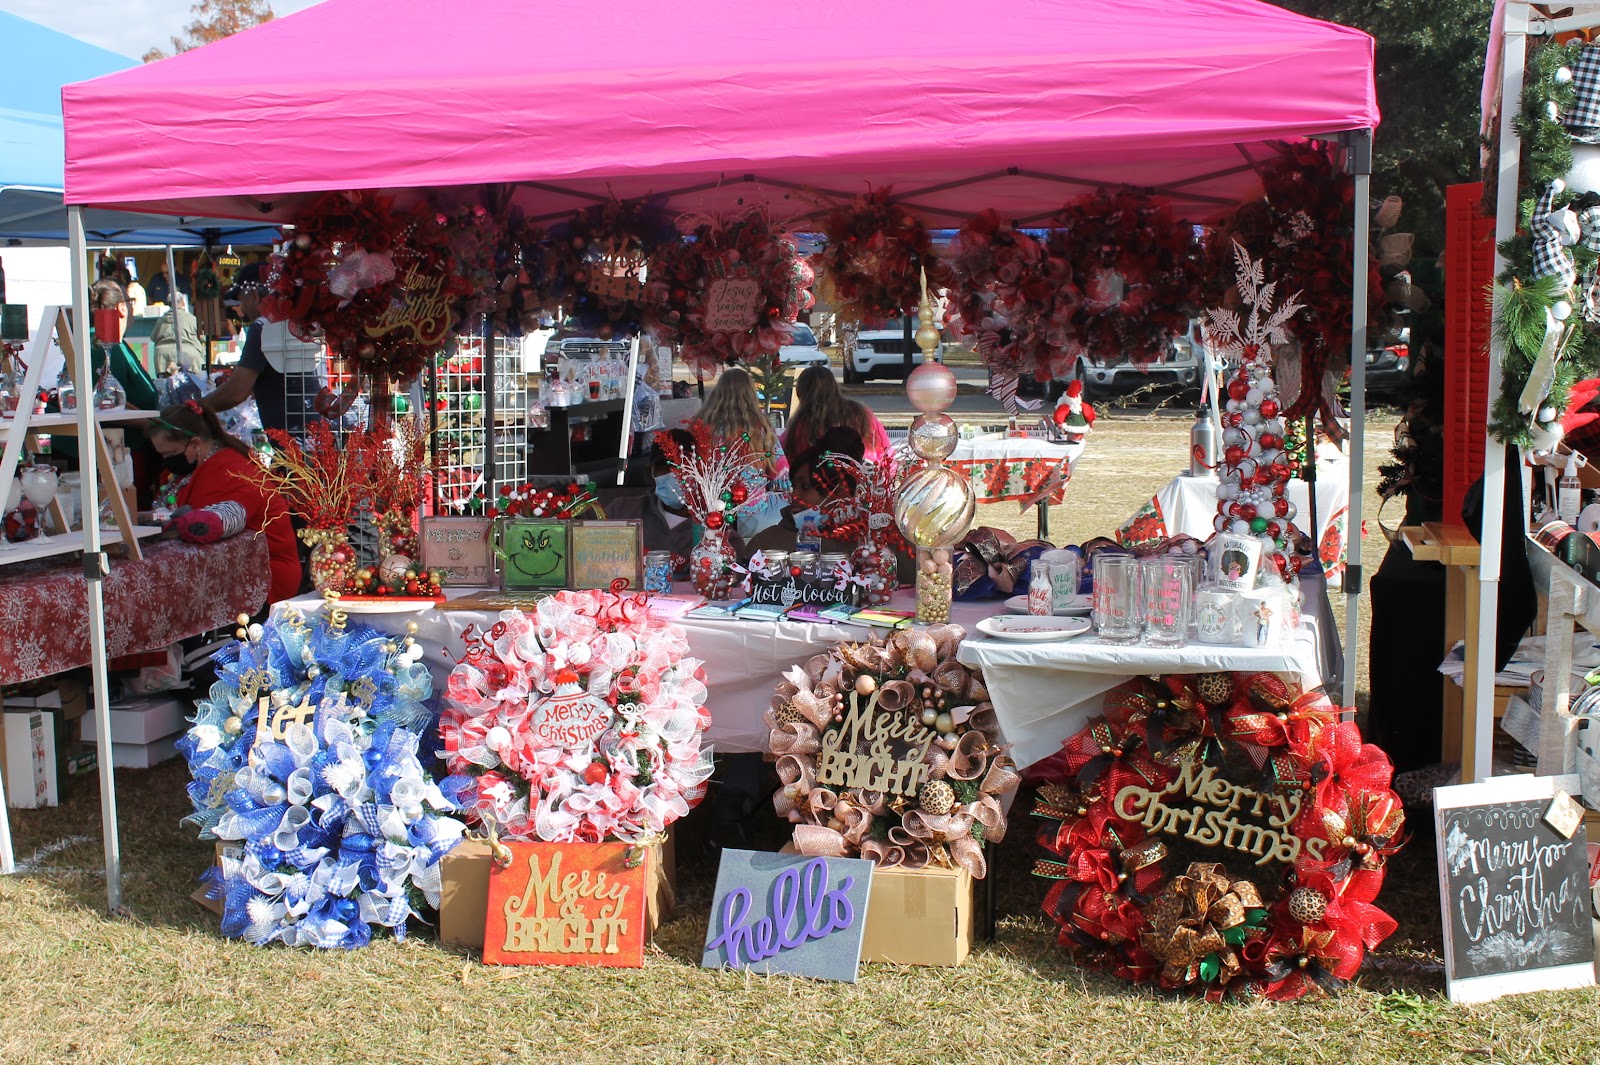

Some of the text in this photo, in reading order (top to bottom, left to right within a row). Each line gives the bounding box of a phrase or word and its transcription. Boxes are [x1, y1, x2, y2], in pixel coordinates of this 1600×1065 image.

[221, 258, 238, 266] ORDER
[715, 282, 752, 302] Jesus
[716, 302, 748, 313] reason
[712, 318, 746, 329] season
[751, 583, 849, 604] Hot Cocoa
[539, 711, 610, 747] Christmas
[544, 701, 597, 722] Merry
[822, 690, 937, 763] Merry
[870, 729, 893, 758] &
[816, 750, 930, 797] BRIGHT
[1166, 760, 1303, 828] Merry
[1114, 785, 1328, 866] Christmas
[504, 851, 630, 919] Merry
[1467, 835, 1573, 902] Merry
[559, 889, 585, 920] &
[709, 857, 855, 969] hello
[503, 917, 628, 953] BRIGHT
